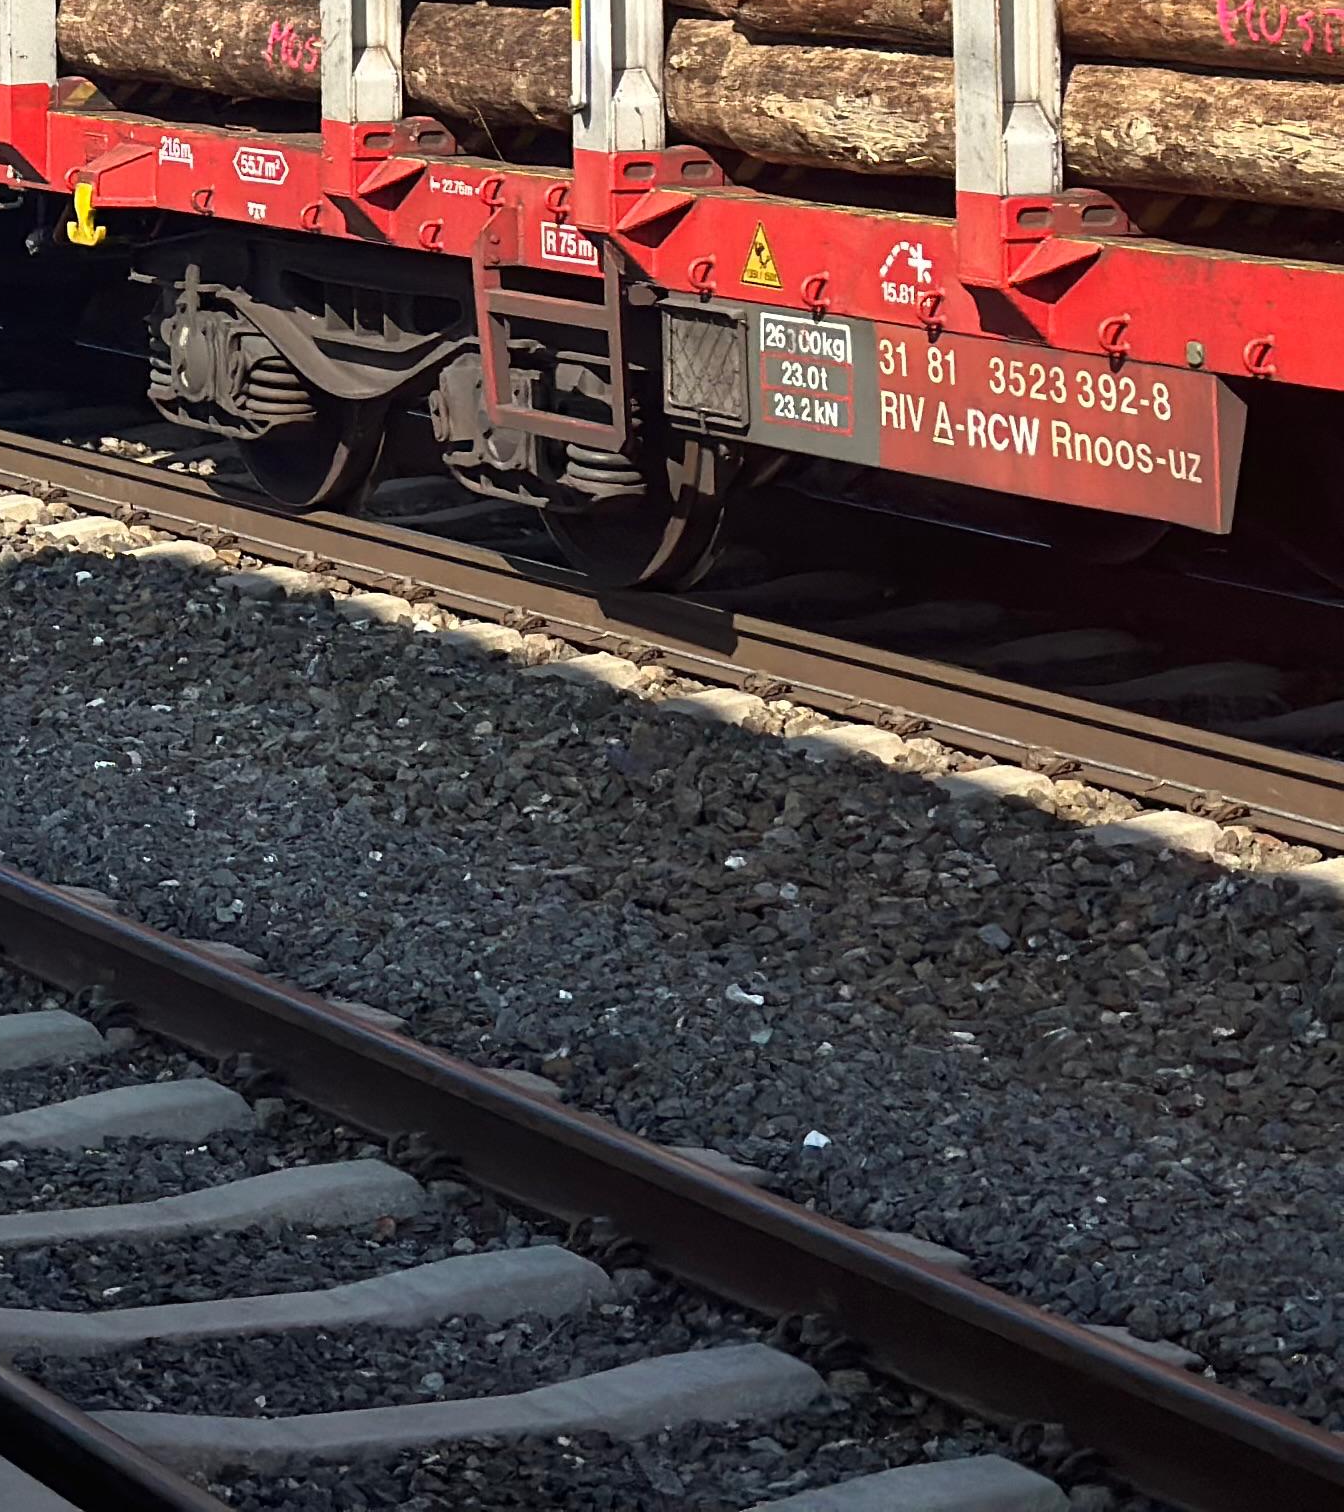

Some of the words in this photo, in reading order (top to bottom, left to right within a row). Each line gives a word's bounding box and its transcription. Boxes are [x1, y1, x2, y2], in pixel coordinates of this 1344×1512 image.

[546, 230, 557, 252] R
[879, 339, 909, 377] 31
[927, 347, 957, 386] 81
[988, 356, 1067, 404] 3523
[1076, 370, 1172, 421] 392-8
[880, 390, 925, 432] RIV
[933, 401, 1040, 457] A-RCW
[1050, 420, 1203, 484] Rnoos-uz
